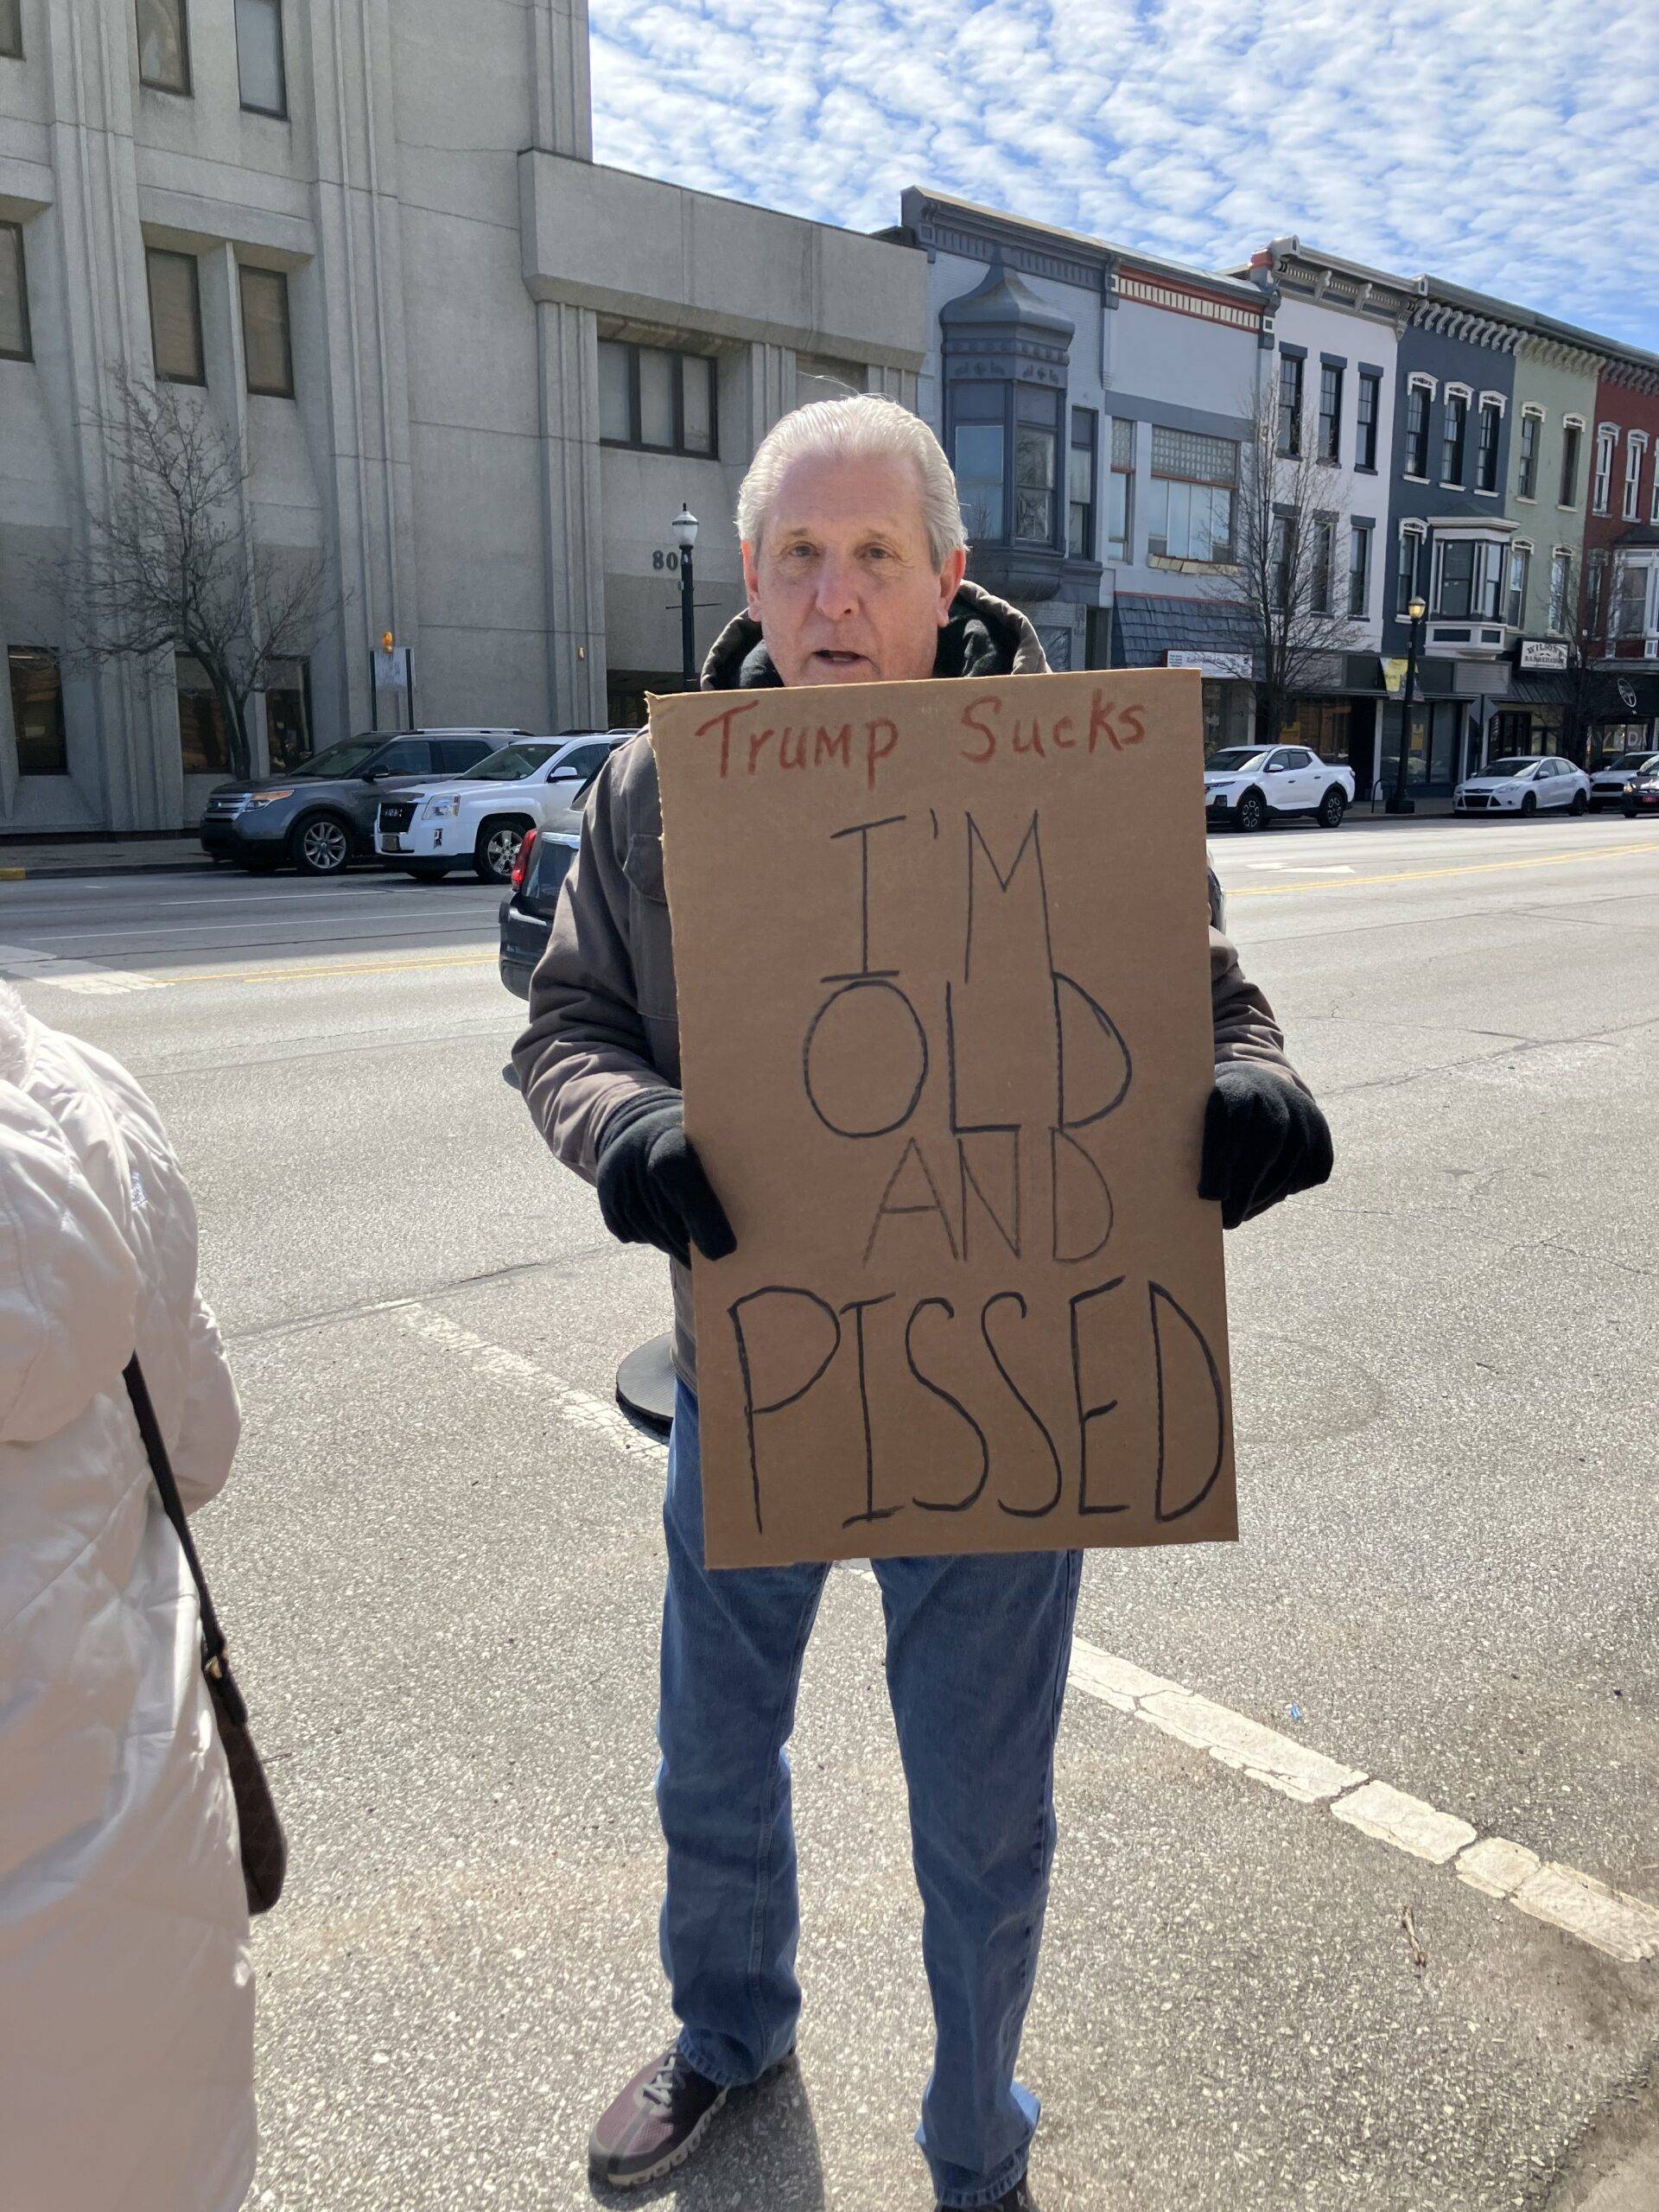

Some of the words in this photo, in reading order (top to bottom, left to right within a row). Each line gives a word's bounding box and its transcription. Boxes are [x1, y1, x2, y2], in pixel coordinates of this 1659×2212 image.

[695, 699, 899, 791] Trump
[961, 689, 1147, 764] Sucks
[820, 809, 1053, 982] I'M
[803, 971, 1133, 1139] OLD
[863, 1126, 1114, 1264] AND
[727, 1275, 1224, 1535] PISSED
